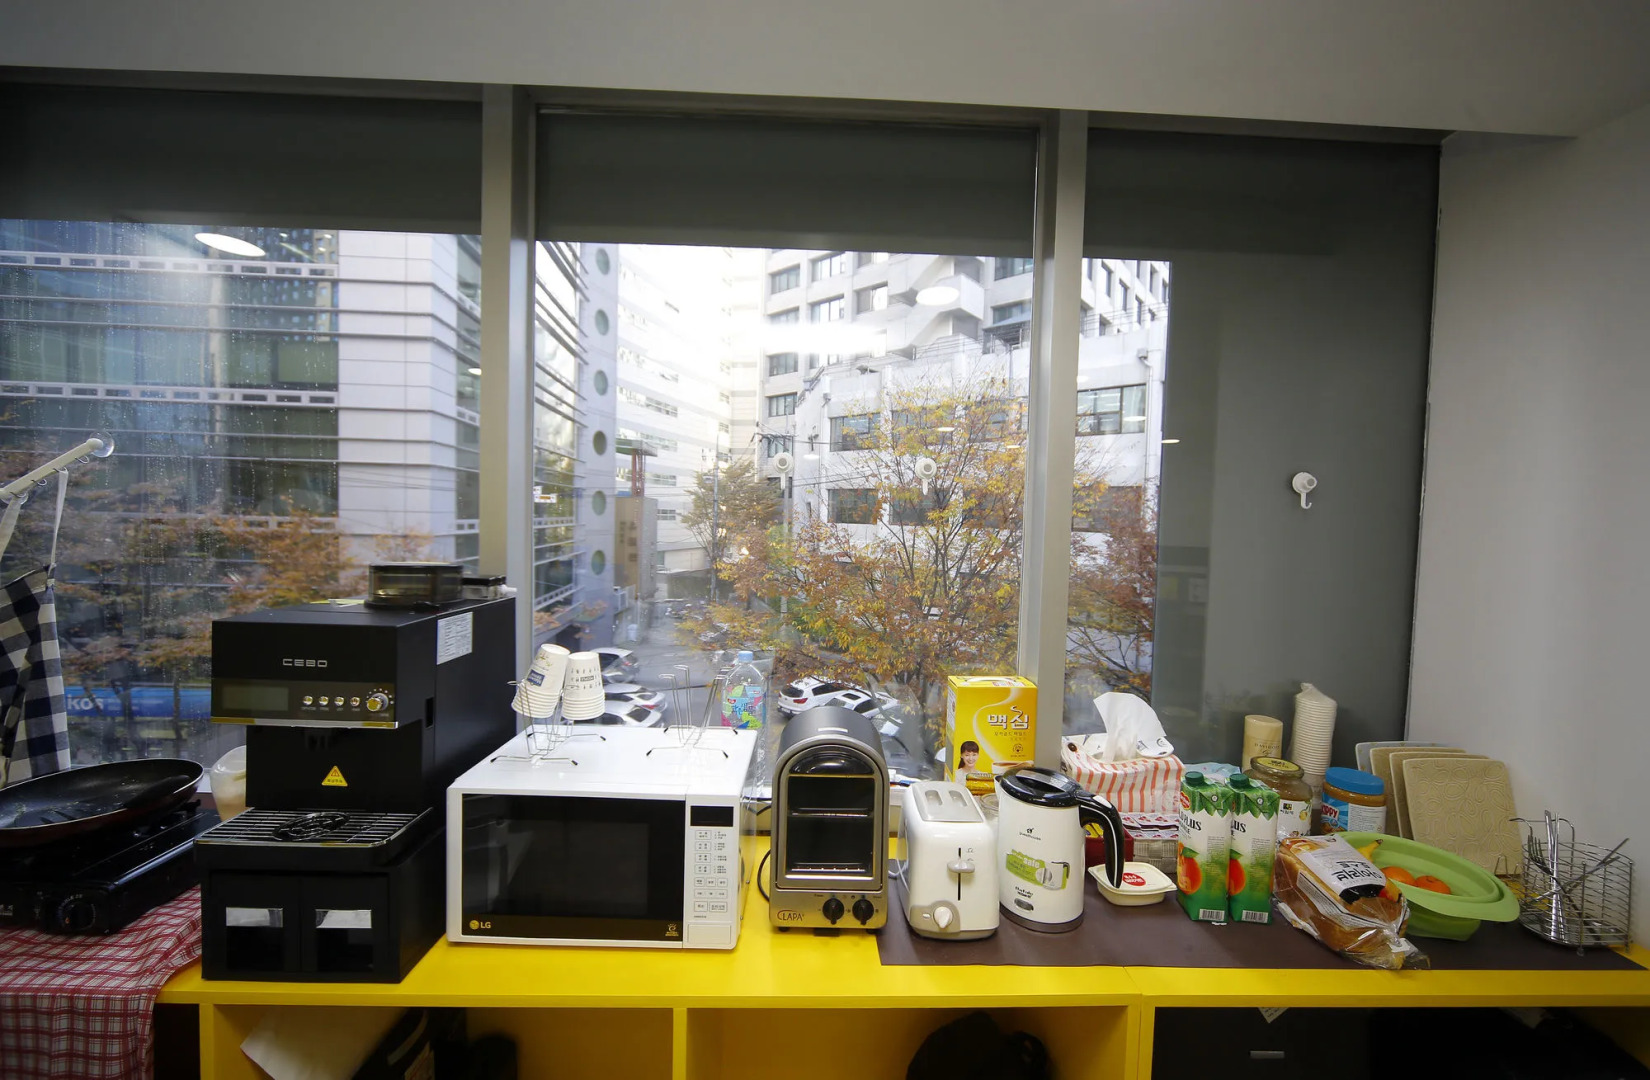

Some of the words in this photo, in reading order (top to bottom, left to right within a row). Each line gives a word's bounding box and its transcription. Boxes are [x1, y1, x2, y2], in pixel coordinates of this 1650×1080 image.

[282, 658, 328, 668] CEBO
[987, 706, 1029, 730] 맥심
[777, 910, 803, 921] CLAPA
[480, 921, 491, 929] LG
